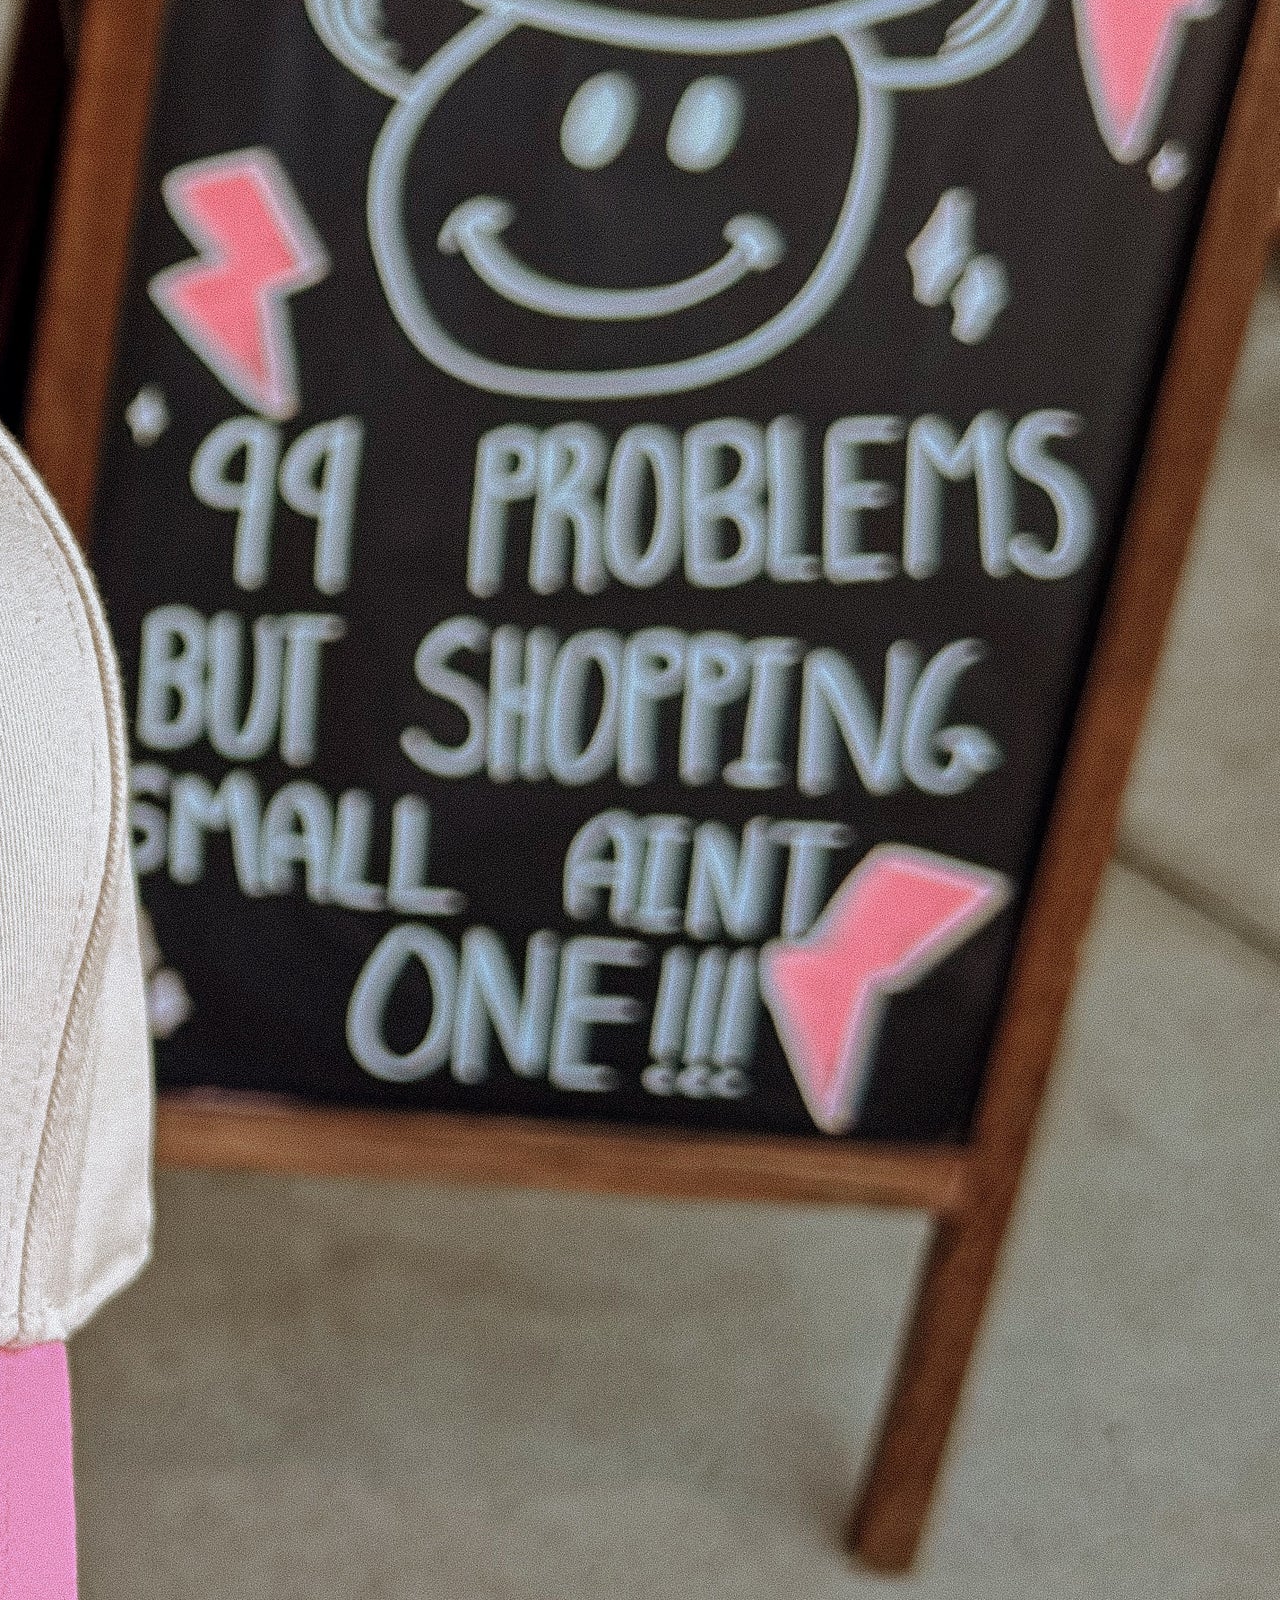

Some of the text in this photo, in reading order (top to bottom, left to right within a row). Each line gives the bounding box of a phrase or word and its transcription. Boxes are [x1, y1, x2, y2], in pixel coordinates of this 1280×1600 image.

[191, 408, 1095, 596] 99 PROBLEMS
[139, 605, 1000, 794] BUT SHOPPING
[130, 763, 855, 943] SMALL AINT
[347, 923, 759, 1097] ONE!!!
